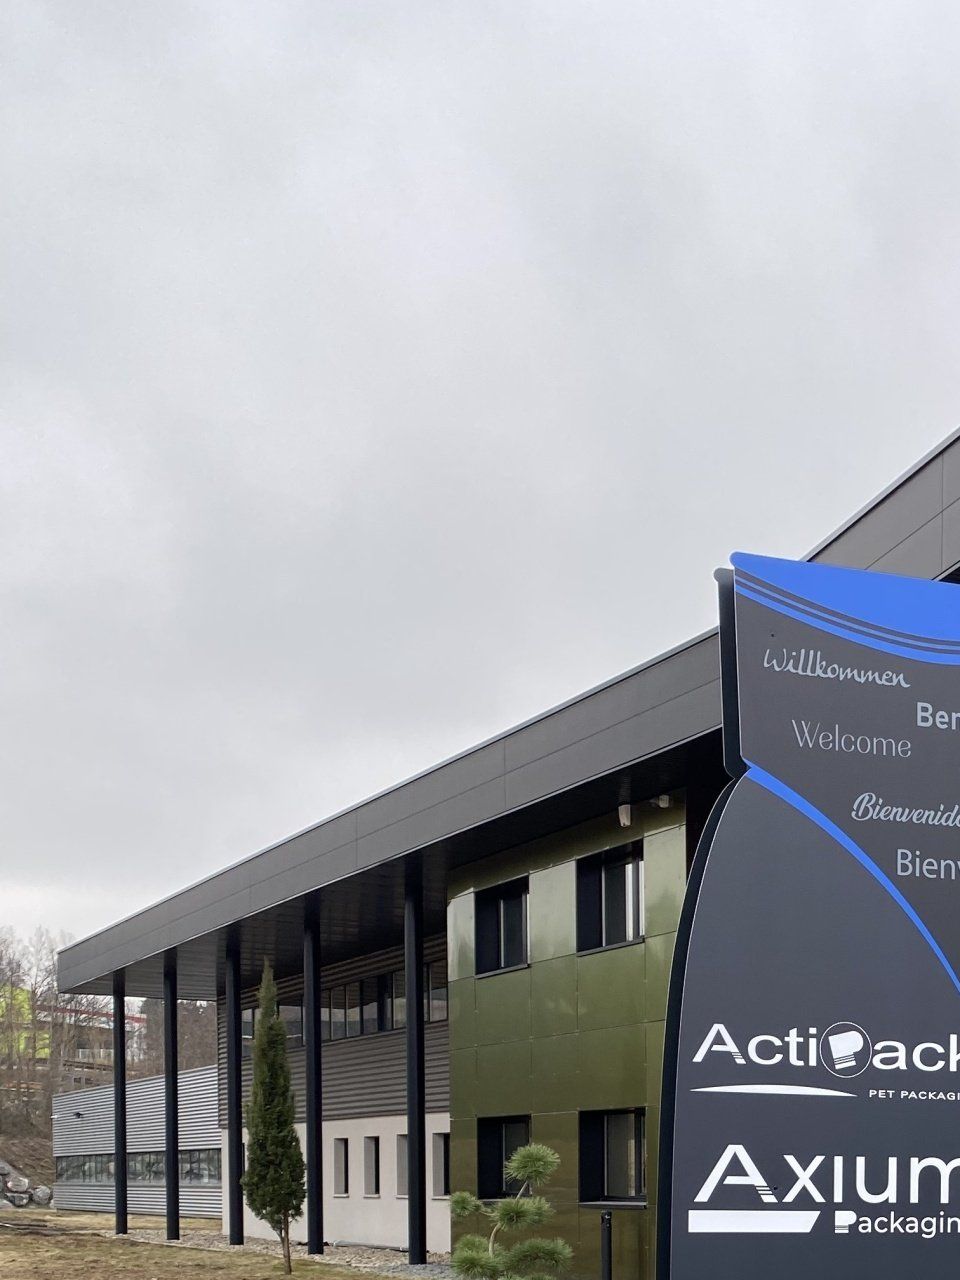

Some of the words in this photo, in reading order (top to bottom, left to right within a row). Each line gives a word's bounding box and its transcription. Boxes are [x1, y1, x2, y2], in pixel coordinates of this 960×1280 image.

[763, 647, 911, 688] Willkommen
[791, 719, 912, 758] Welcome
[869, 1089, 895, 1099] PET
